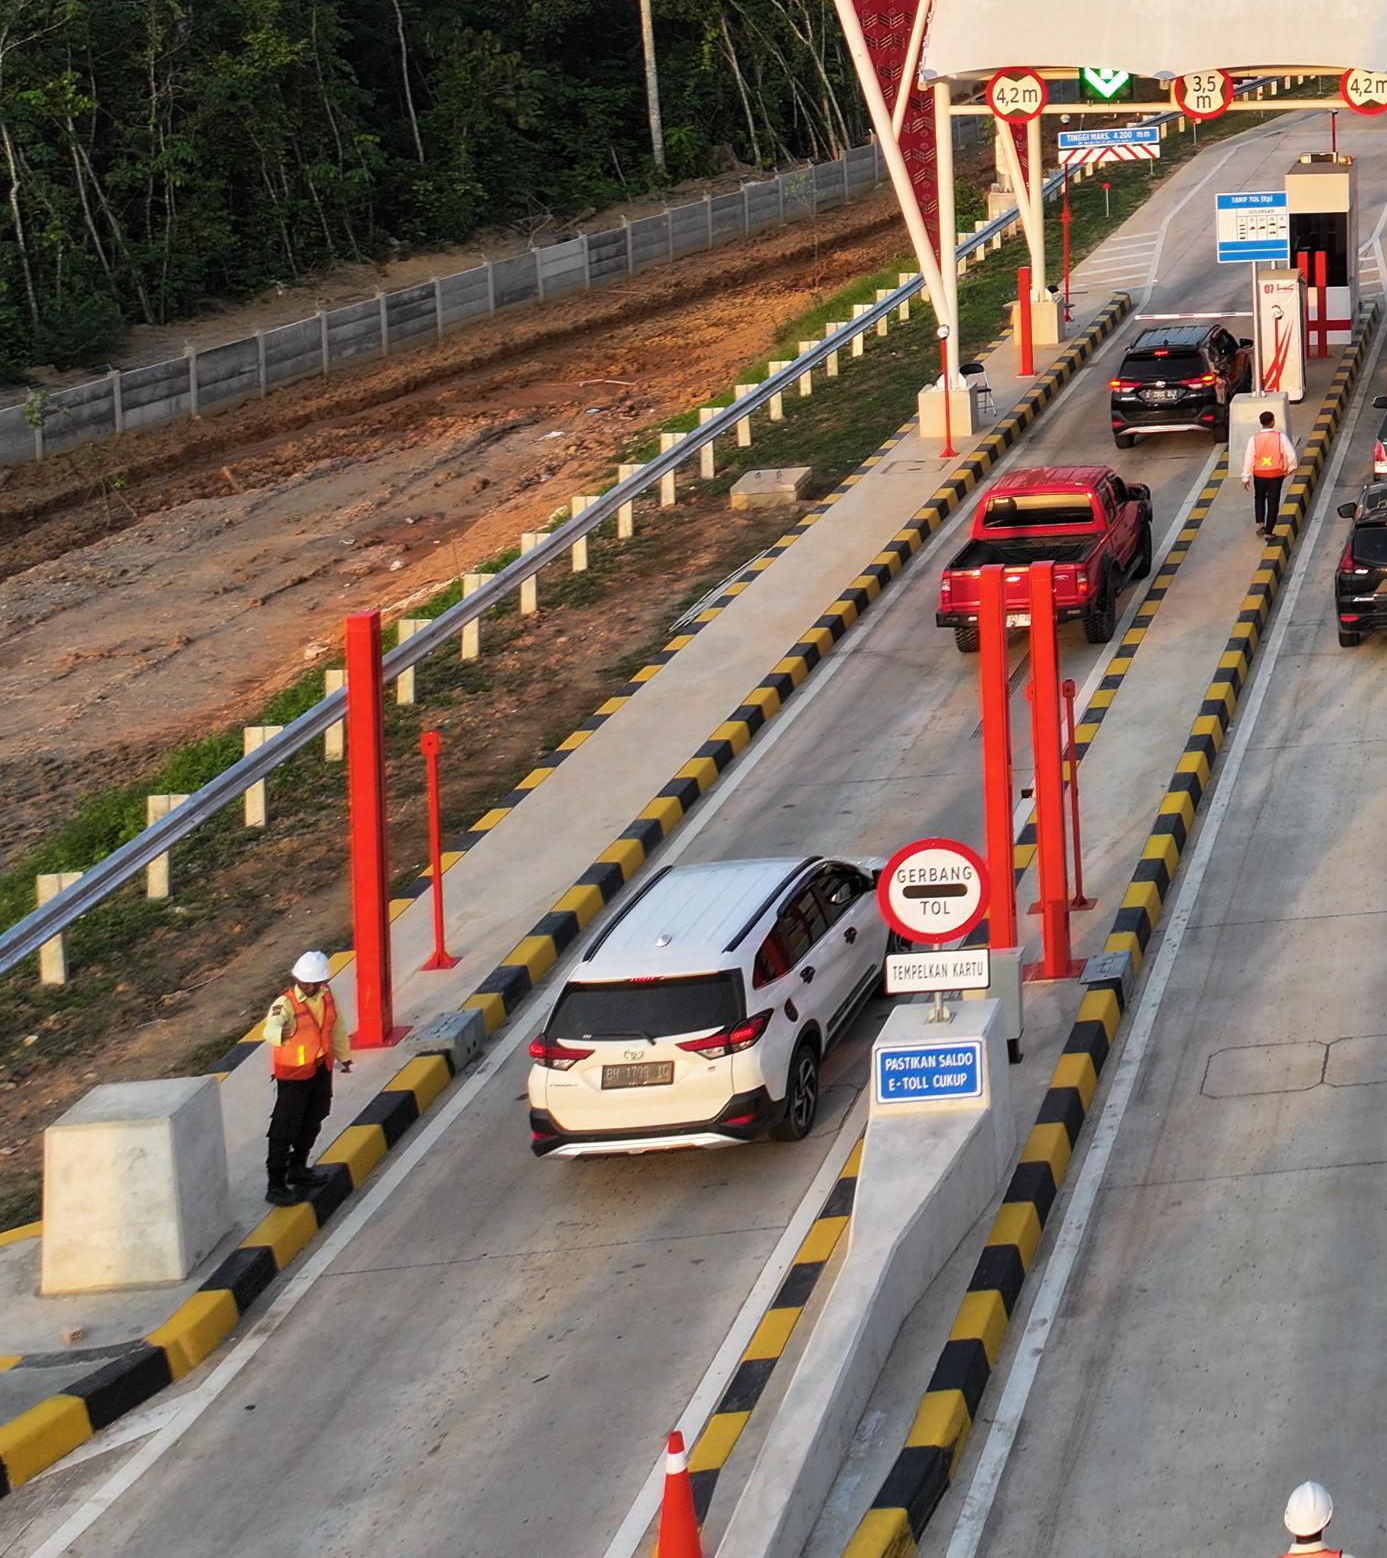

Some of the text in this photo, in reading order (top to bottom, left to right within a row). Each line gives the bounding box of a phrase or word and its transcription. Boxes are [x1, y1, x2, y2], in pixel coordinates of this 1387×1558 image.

[1192, 75, 1216, 94] 3,5
[1196, 95, 1212, 109] m
[1067, 133, 1090, 142] TINGGI
[1264, 284, 1274, 294] 07
[897, 865, 972, 884] GERBANG
[919, 899, 951, 916] TOL
[892, 960, 984, 981] TEMPELKAN KARTU
[885, 1052, 973, 1072] PASTIKAN SALDO
[606, 1068, 619, 1080] BH
[888, 1072, 968, 1092] E-TOLL CUKUP
